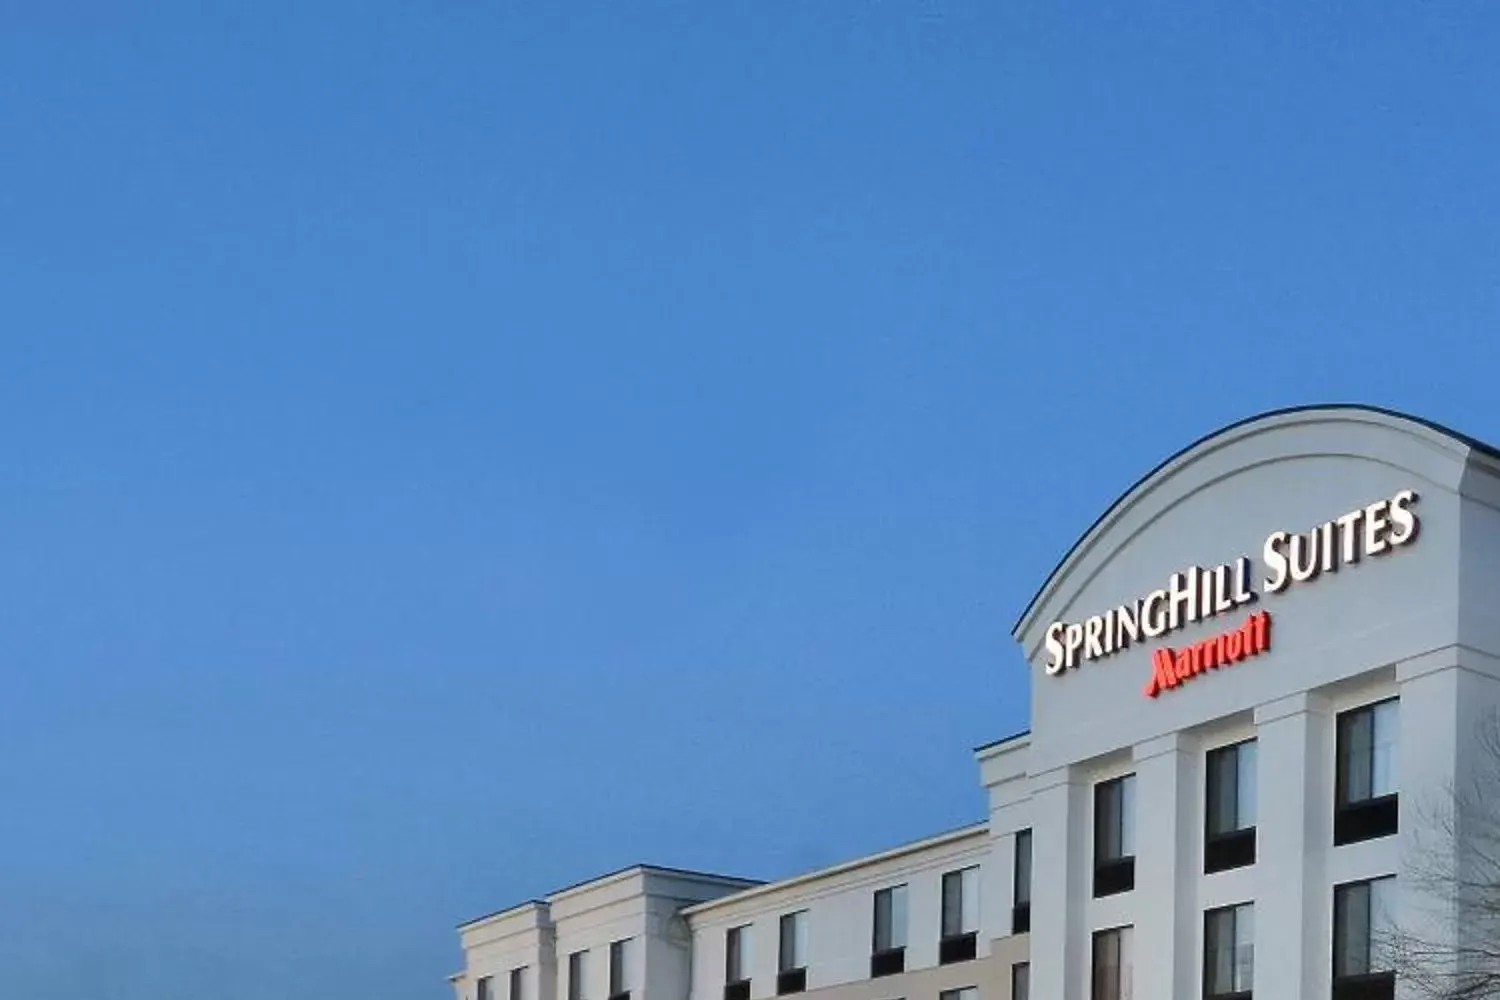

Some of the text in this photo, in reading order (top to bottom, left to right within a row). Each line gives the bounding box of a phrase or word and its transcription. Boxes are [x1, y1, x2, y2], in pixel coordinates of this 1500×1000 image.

[1045, 488, 1420, 677] SPRINGHILL SUITES
[1144, 609, 1274, 698] Marriott
